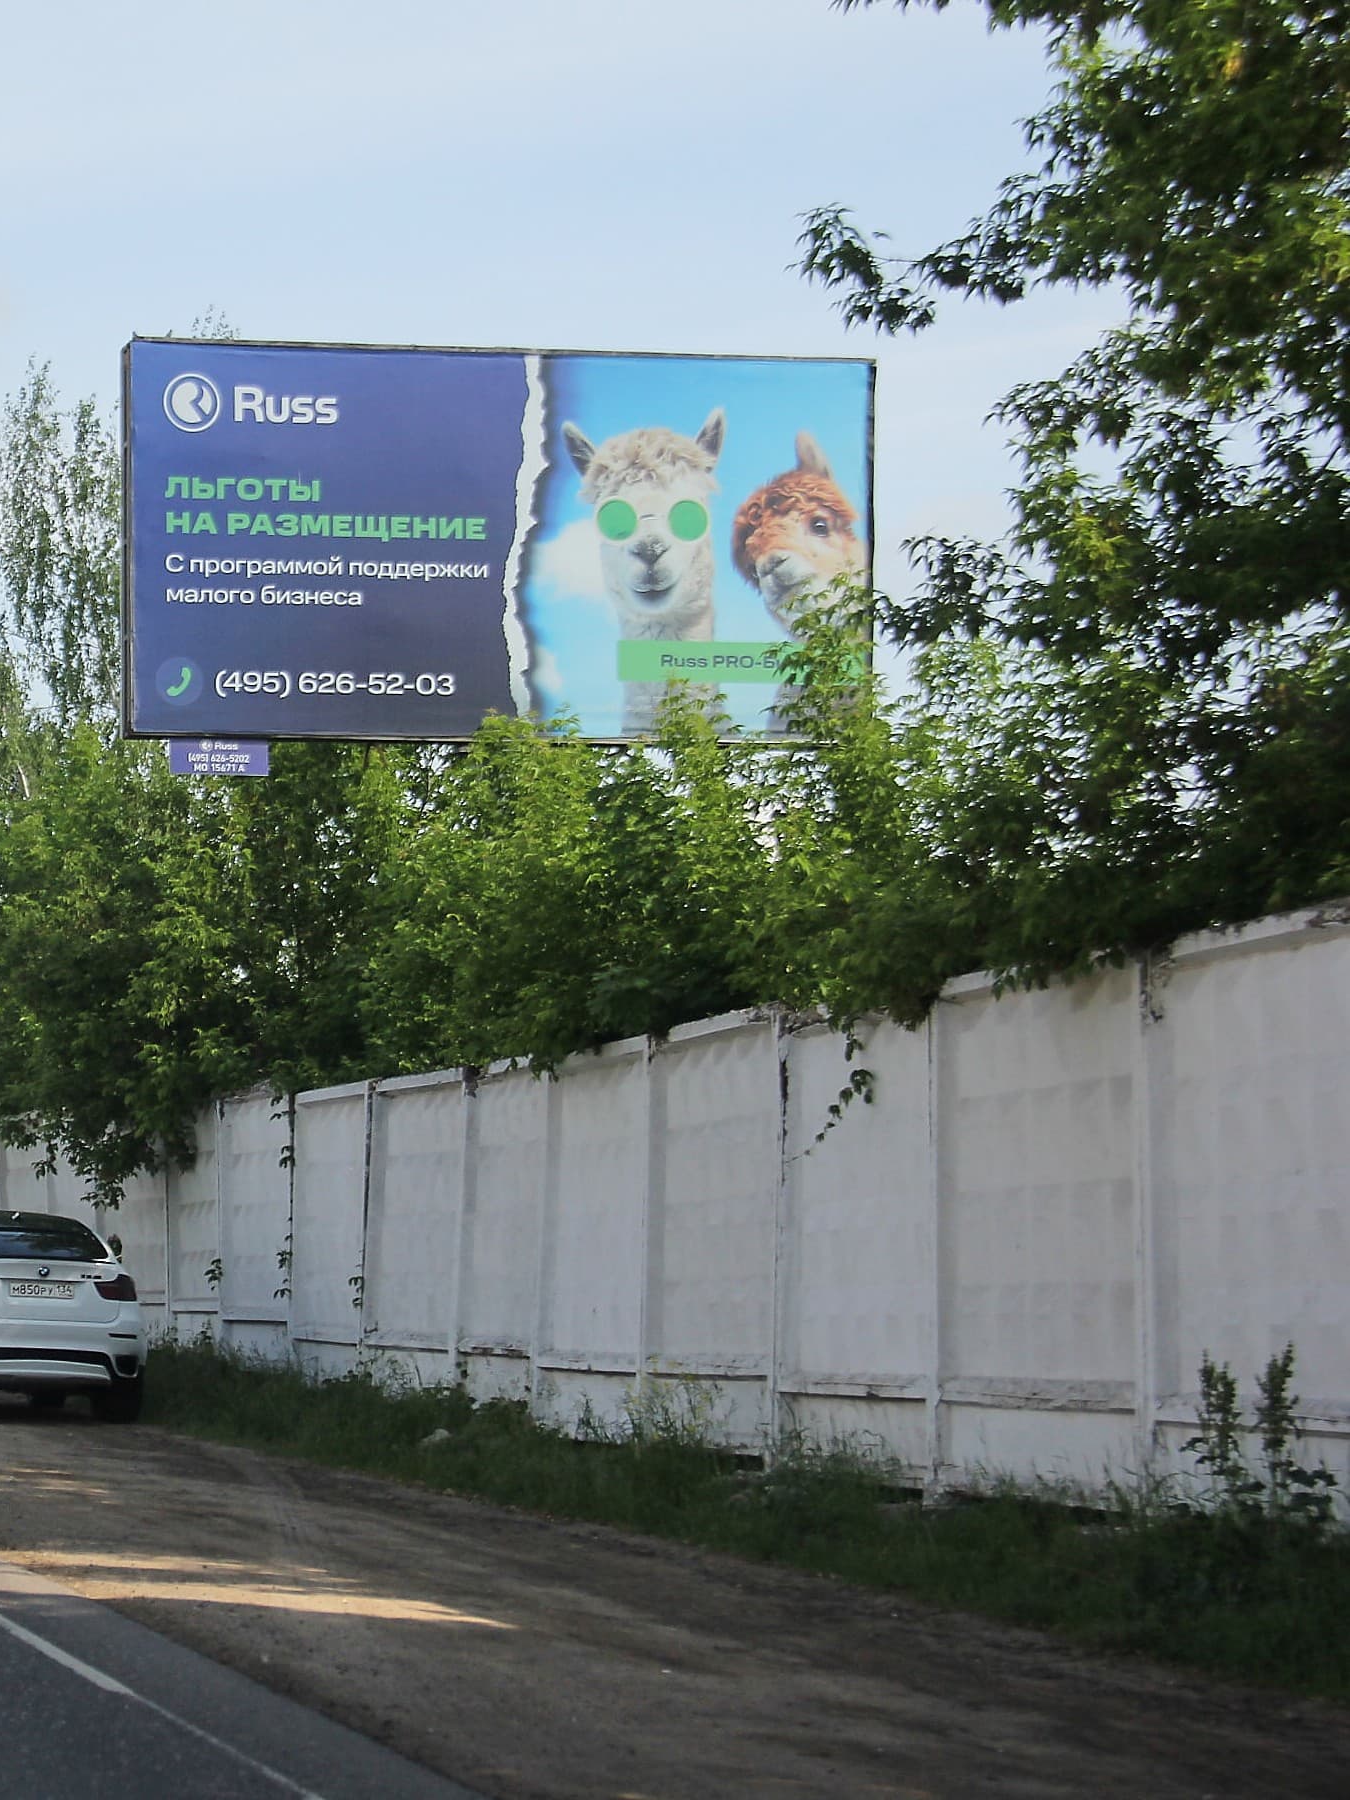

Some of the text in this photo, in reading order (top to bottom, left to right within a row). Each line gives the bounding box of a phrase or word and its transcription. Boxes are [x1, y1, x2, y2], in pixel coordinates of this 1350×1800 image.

[234, 386, 339, 423] Russ
[165, 476, 321, 502] ЛЬГОТЫ
[165, 512, 486, 541] НА РАЗМЕЩЕНИЕ
[165, 555, 489, 580] С программой поддержки
[165, 585, 363, 606] малого бизнеса
[660, 654, 708, 669] Russ
[214, 670, 455, 698] (495) 626-52-03
